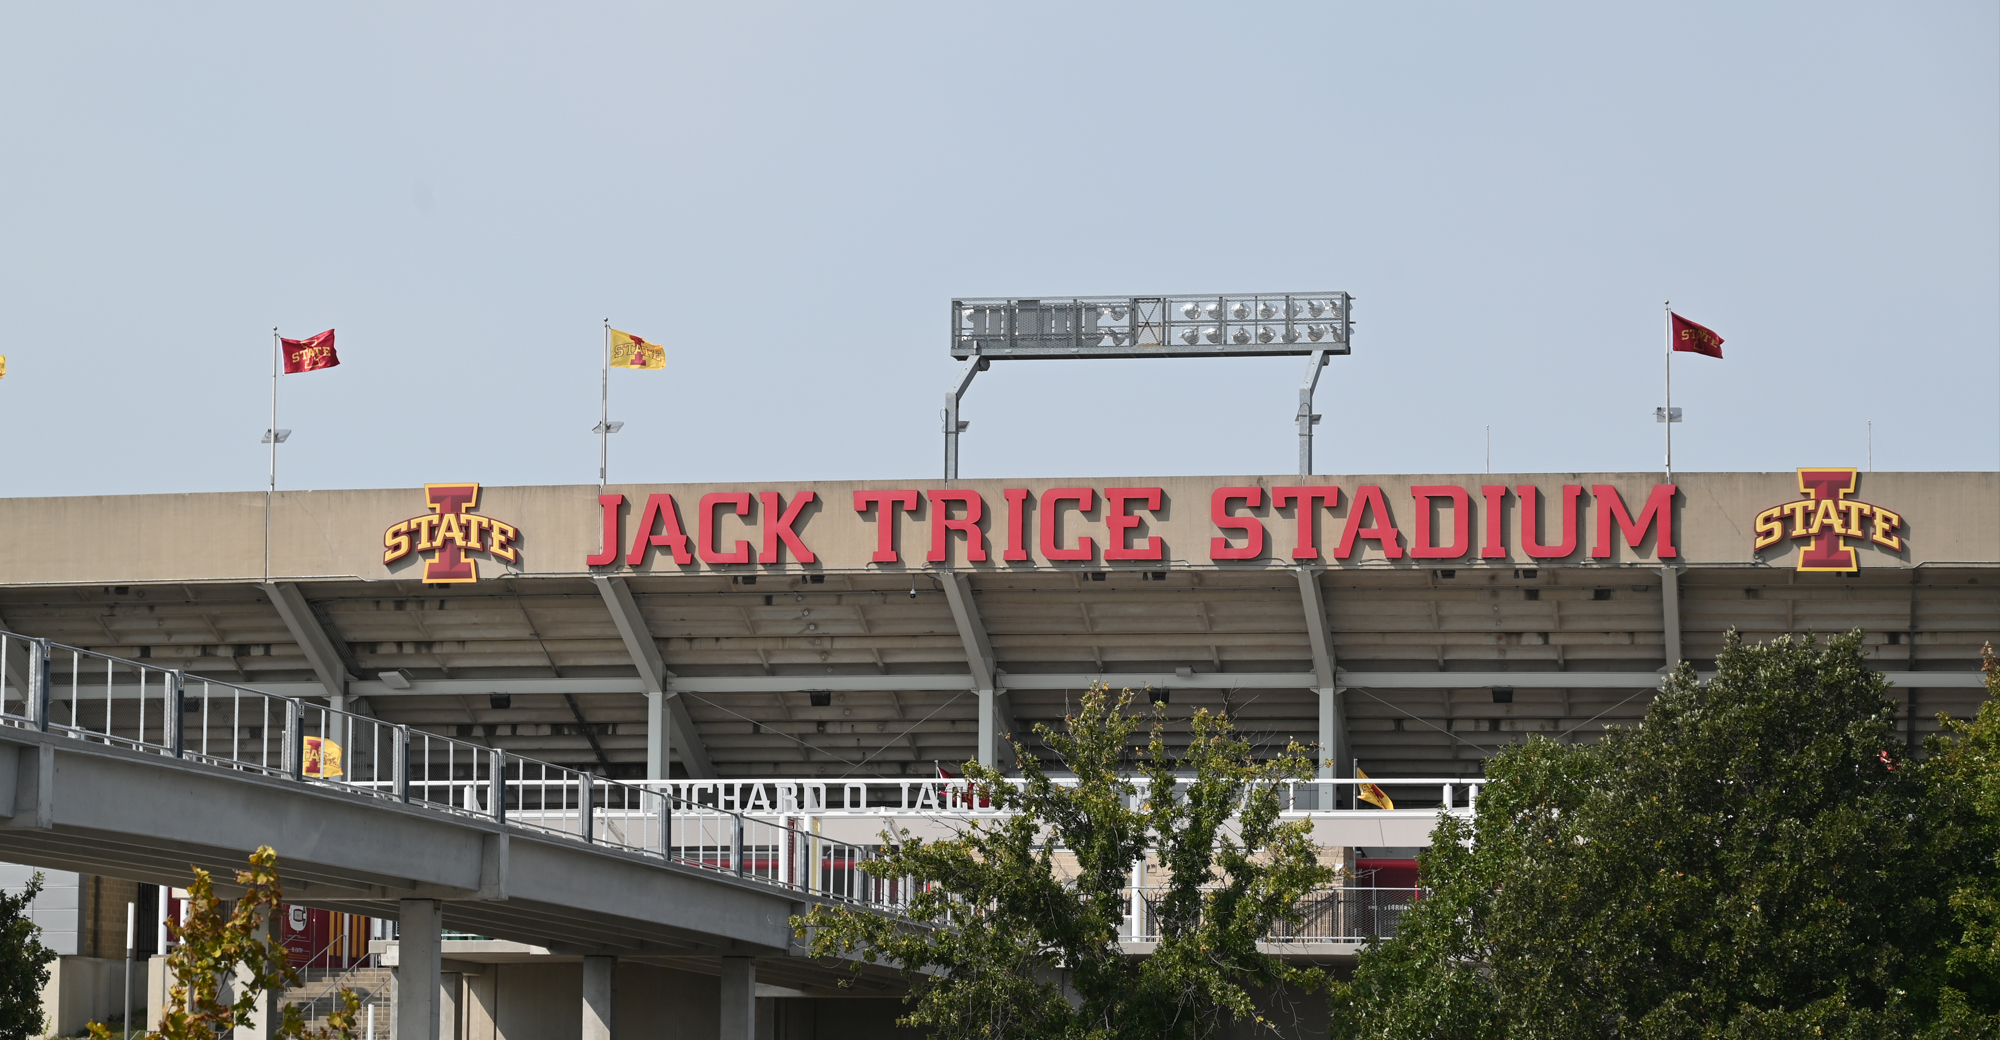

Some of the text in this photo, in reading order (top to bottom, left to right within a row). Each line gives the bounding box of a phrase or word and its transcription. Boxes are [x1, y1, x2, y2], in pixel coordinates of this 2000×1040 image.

[614, 343, 662, 362] STATE
[1681, 329, 1718, 348] STATE
[292, 347, 331, 363] STATE
[383, 512, 518, 566] STATE
[586, 484, 1677, 566] JACK TRICE STADIUM
[1754, 498, 1902, 553] STATE
[650, 783, 827, 814] RICHARD
